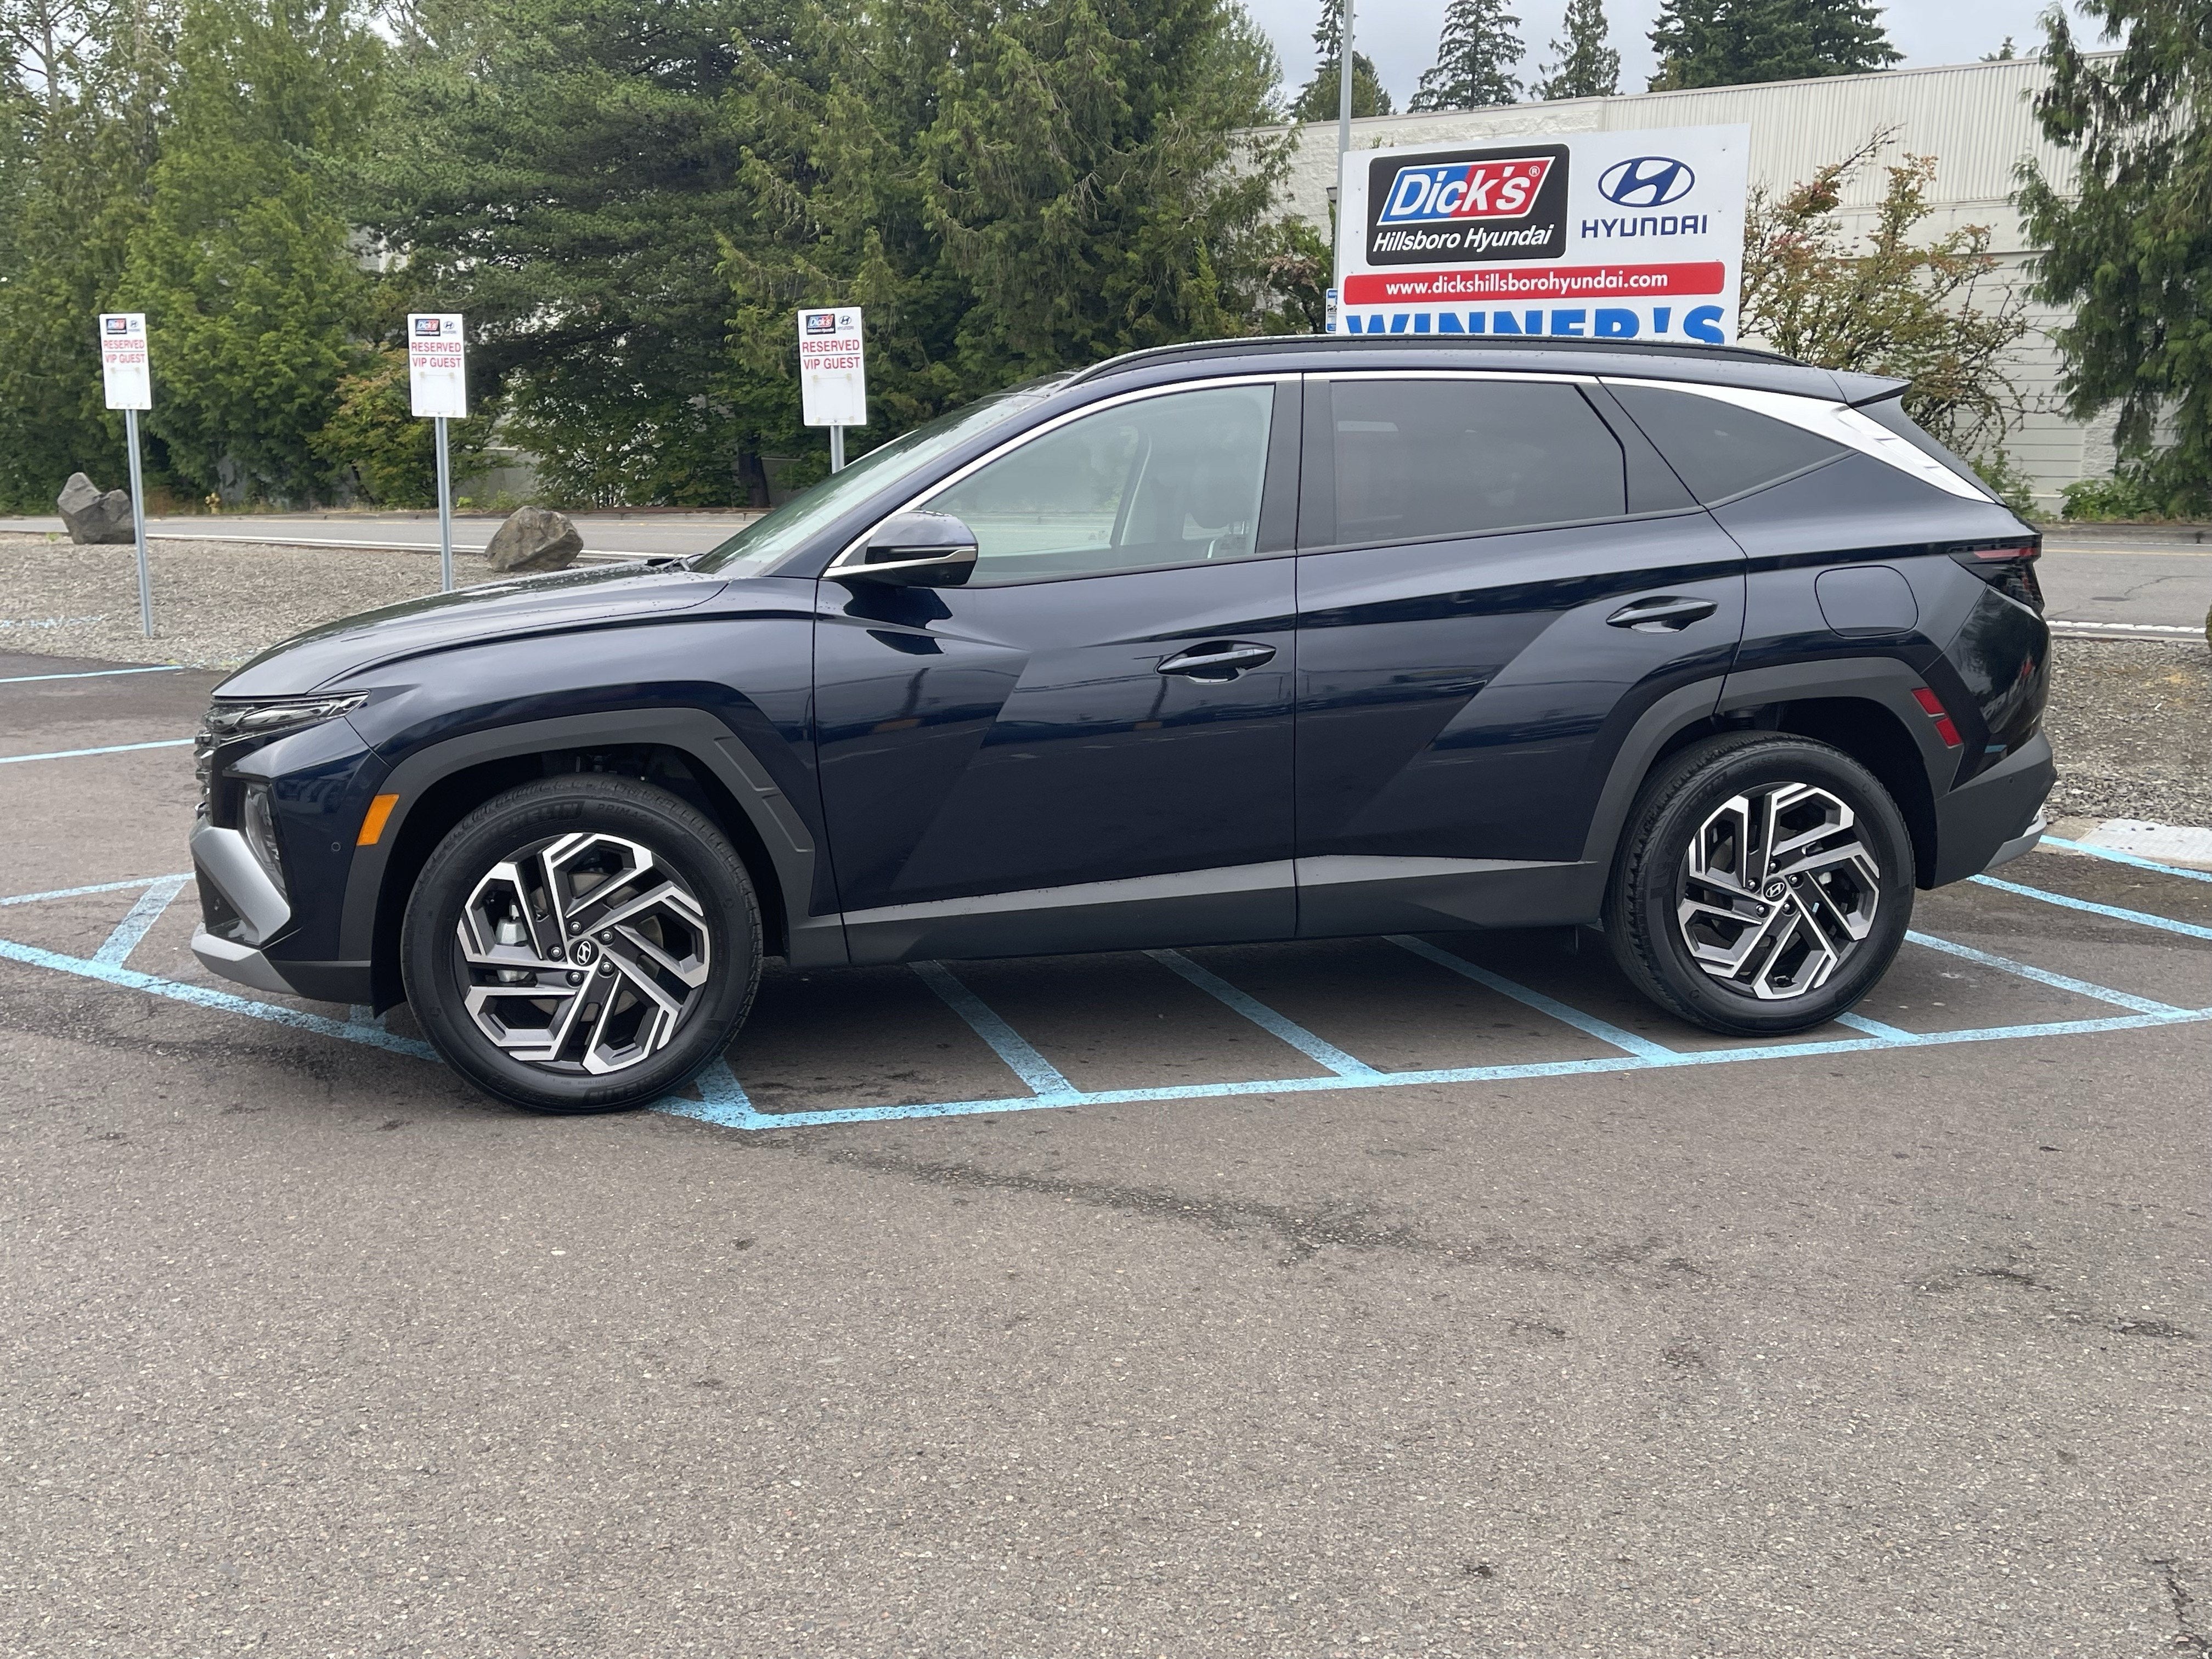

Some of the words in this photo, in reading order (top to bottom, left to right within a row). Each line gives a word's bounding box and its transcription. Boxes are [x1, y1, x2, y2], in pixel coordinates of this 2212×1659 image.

[1389, 166, 1531, 216] Dick's
[1581, 215, 1707, 238] HYUNDAI
[1373, 229, 1462, 252] Hillsboro
[1464, 224, 1555, 252] Hyundai
[1386, 270, 1668, 295] www.dickshillsborohyundai.com
[104, 340, 145, 349] RESERVED
[411, 342, 461, 352] RESERVED
[802, 339, 860, 353] RESERVED
[105, 354, 117, 363] VIP
[119, 354, 145, 363] GUEST
[412, 357, 427, 367] VIP
[430, 358, 461, 368] GUEST
[803, 359, 820, 370] VIP
[823, 357, 860, 369] GUEST
